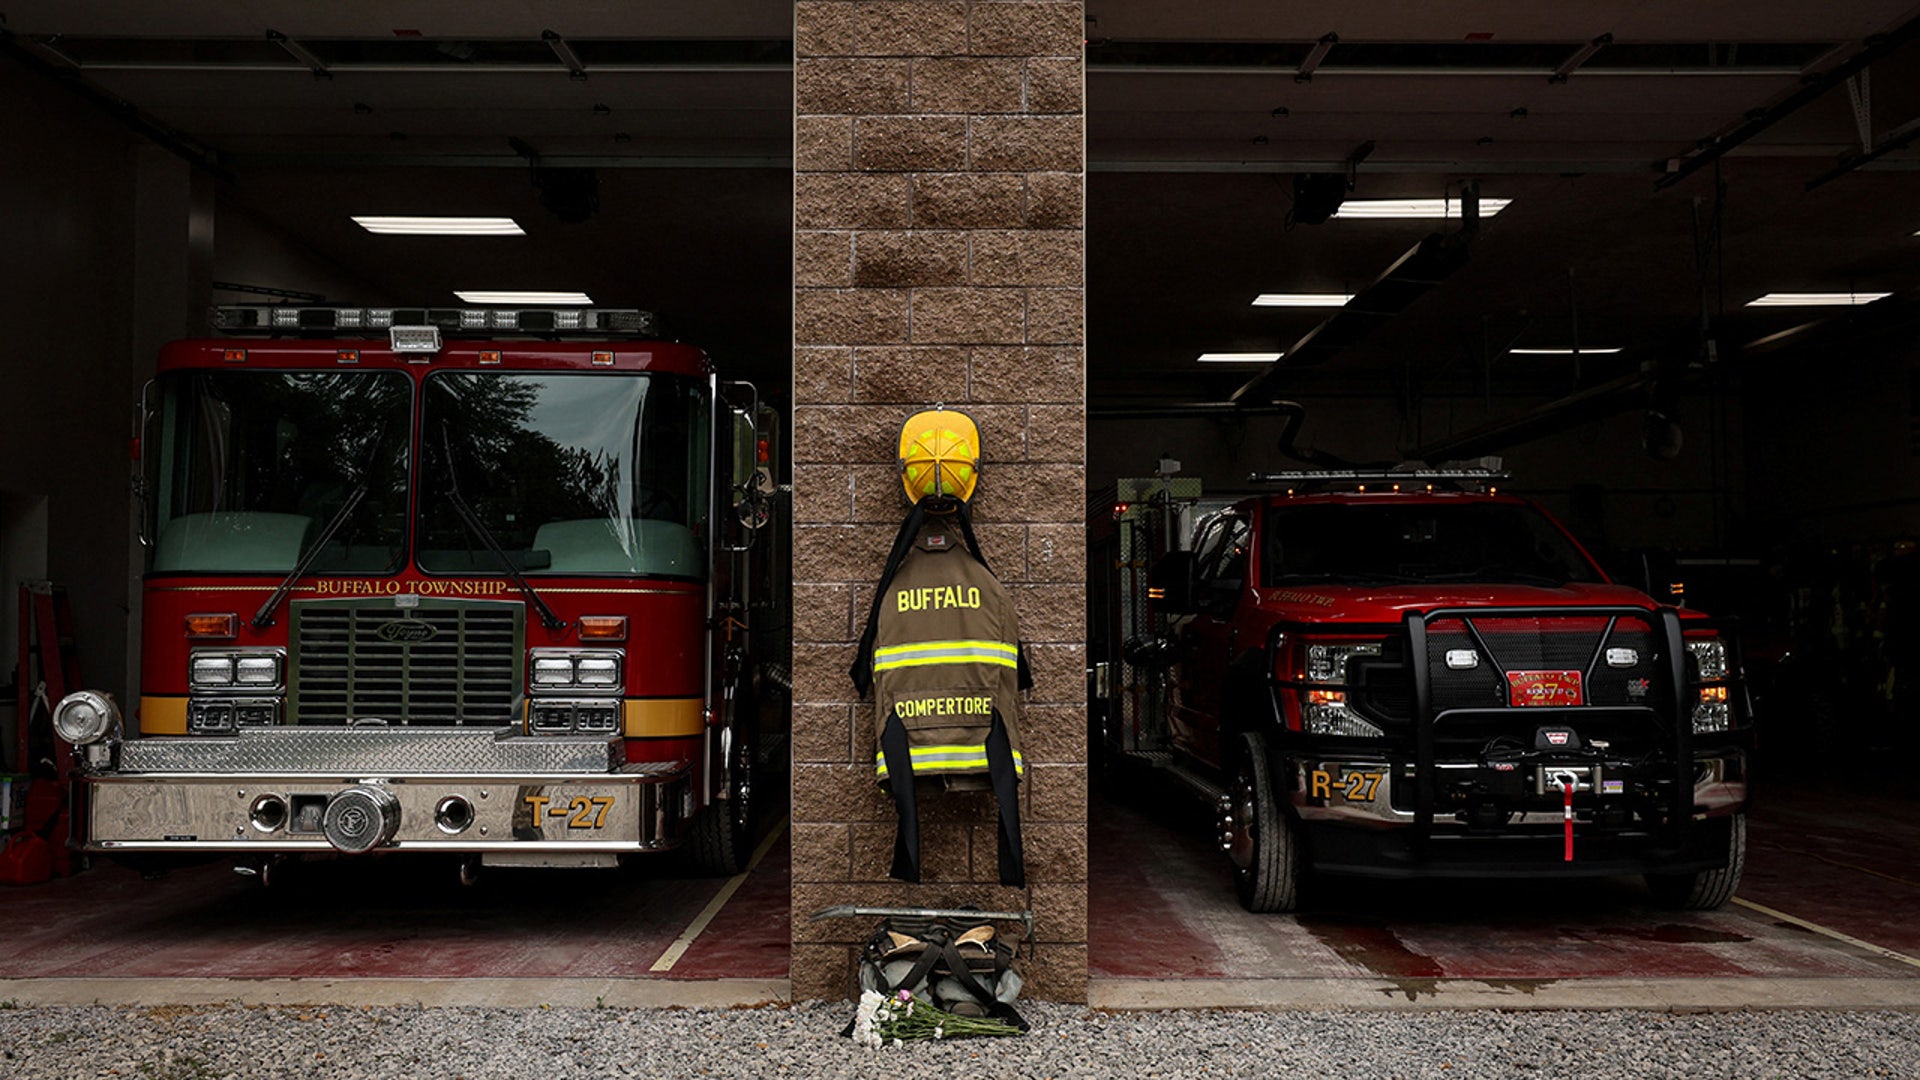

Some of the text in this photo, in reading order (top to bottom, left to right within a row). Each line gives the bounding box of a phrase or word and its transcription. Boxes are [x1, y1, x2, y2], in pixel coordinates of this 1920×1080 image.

[316, 580, 507, 596] BUFFALO TOWNSHIP
[897, 585, 981, 612] BUFFALO
[1531, 682, 1558, 700] 27
[895, 697, 992, 718] COMPERTORE
[1311, 769, 1384, 802] R-27
[525, 795, 616, 828] T-27
